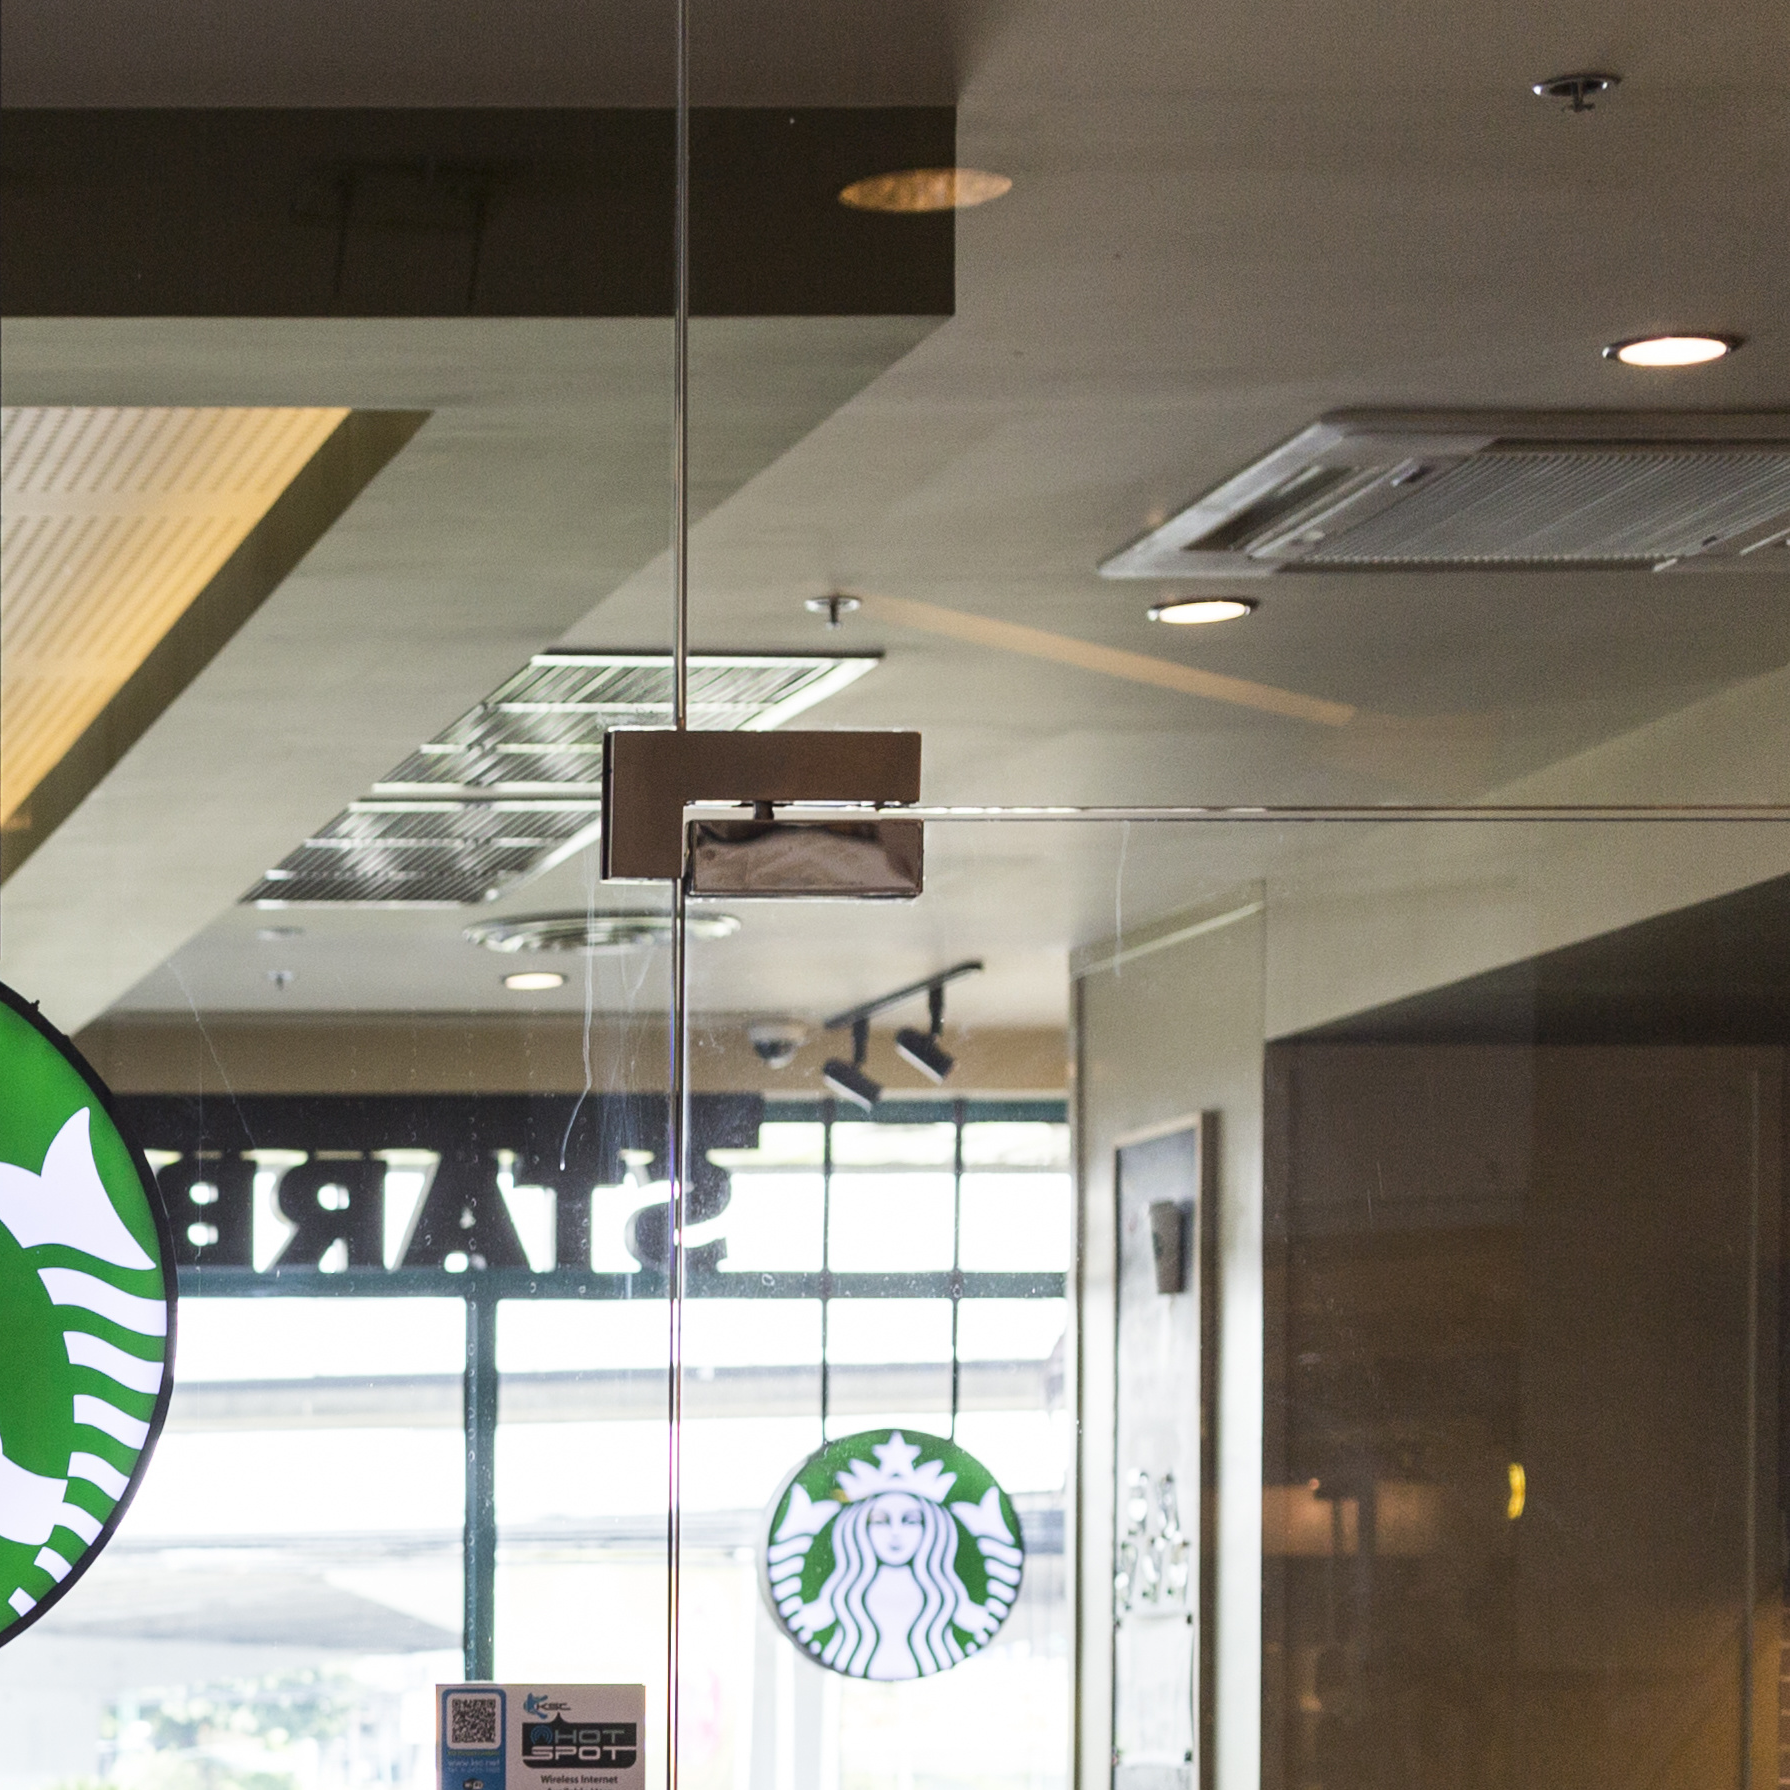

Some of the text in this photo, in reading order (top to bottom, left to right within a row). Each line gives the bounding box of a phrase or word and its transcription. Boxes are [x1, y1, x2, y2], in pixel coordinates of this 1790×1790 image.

[554, 1729, 625, 1744] HOT
[522, 1746, 637, 1761] SPOT
[540, 1774, 618, 1784] Wireless Internet
